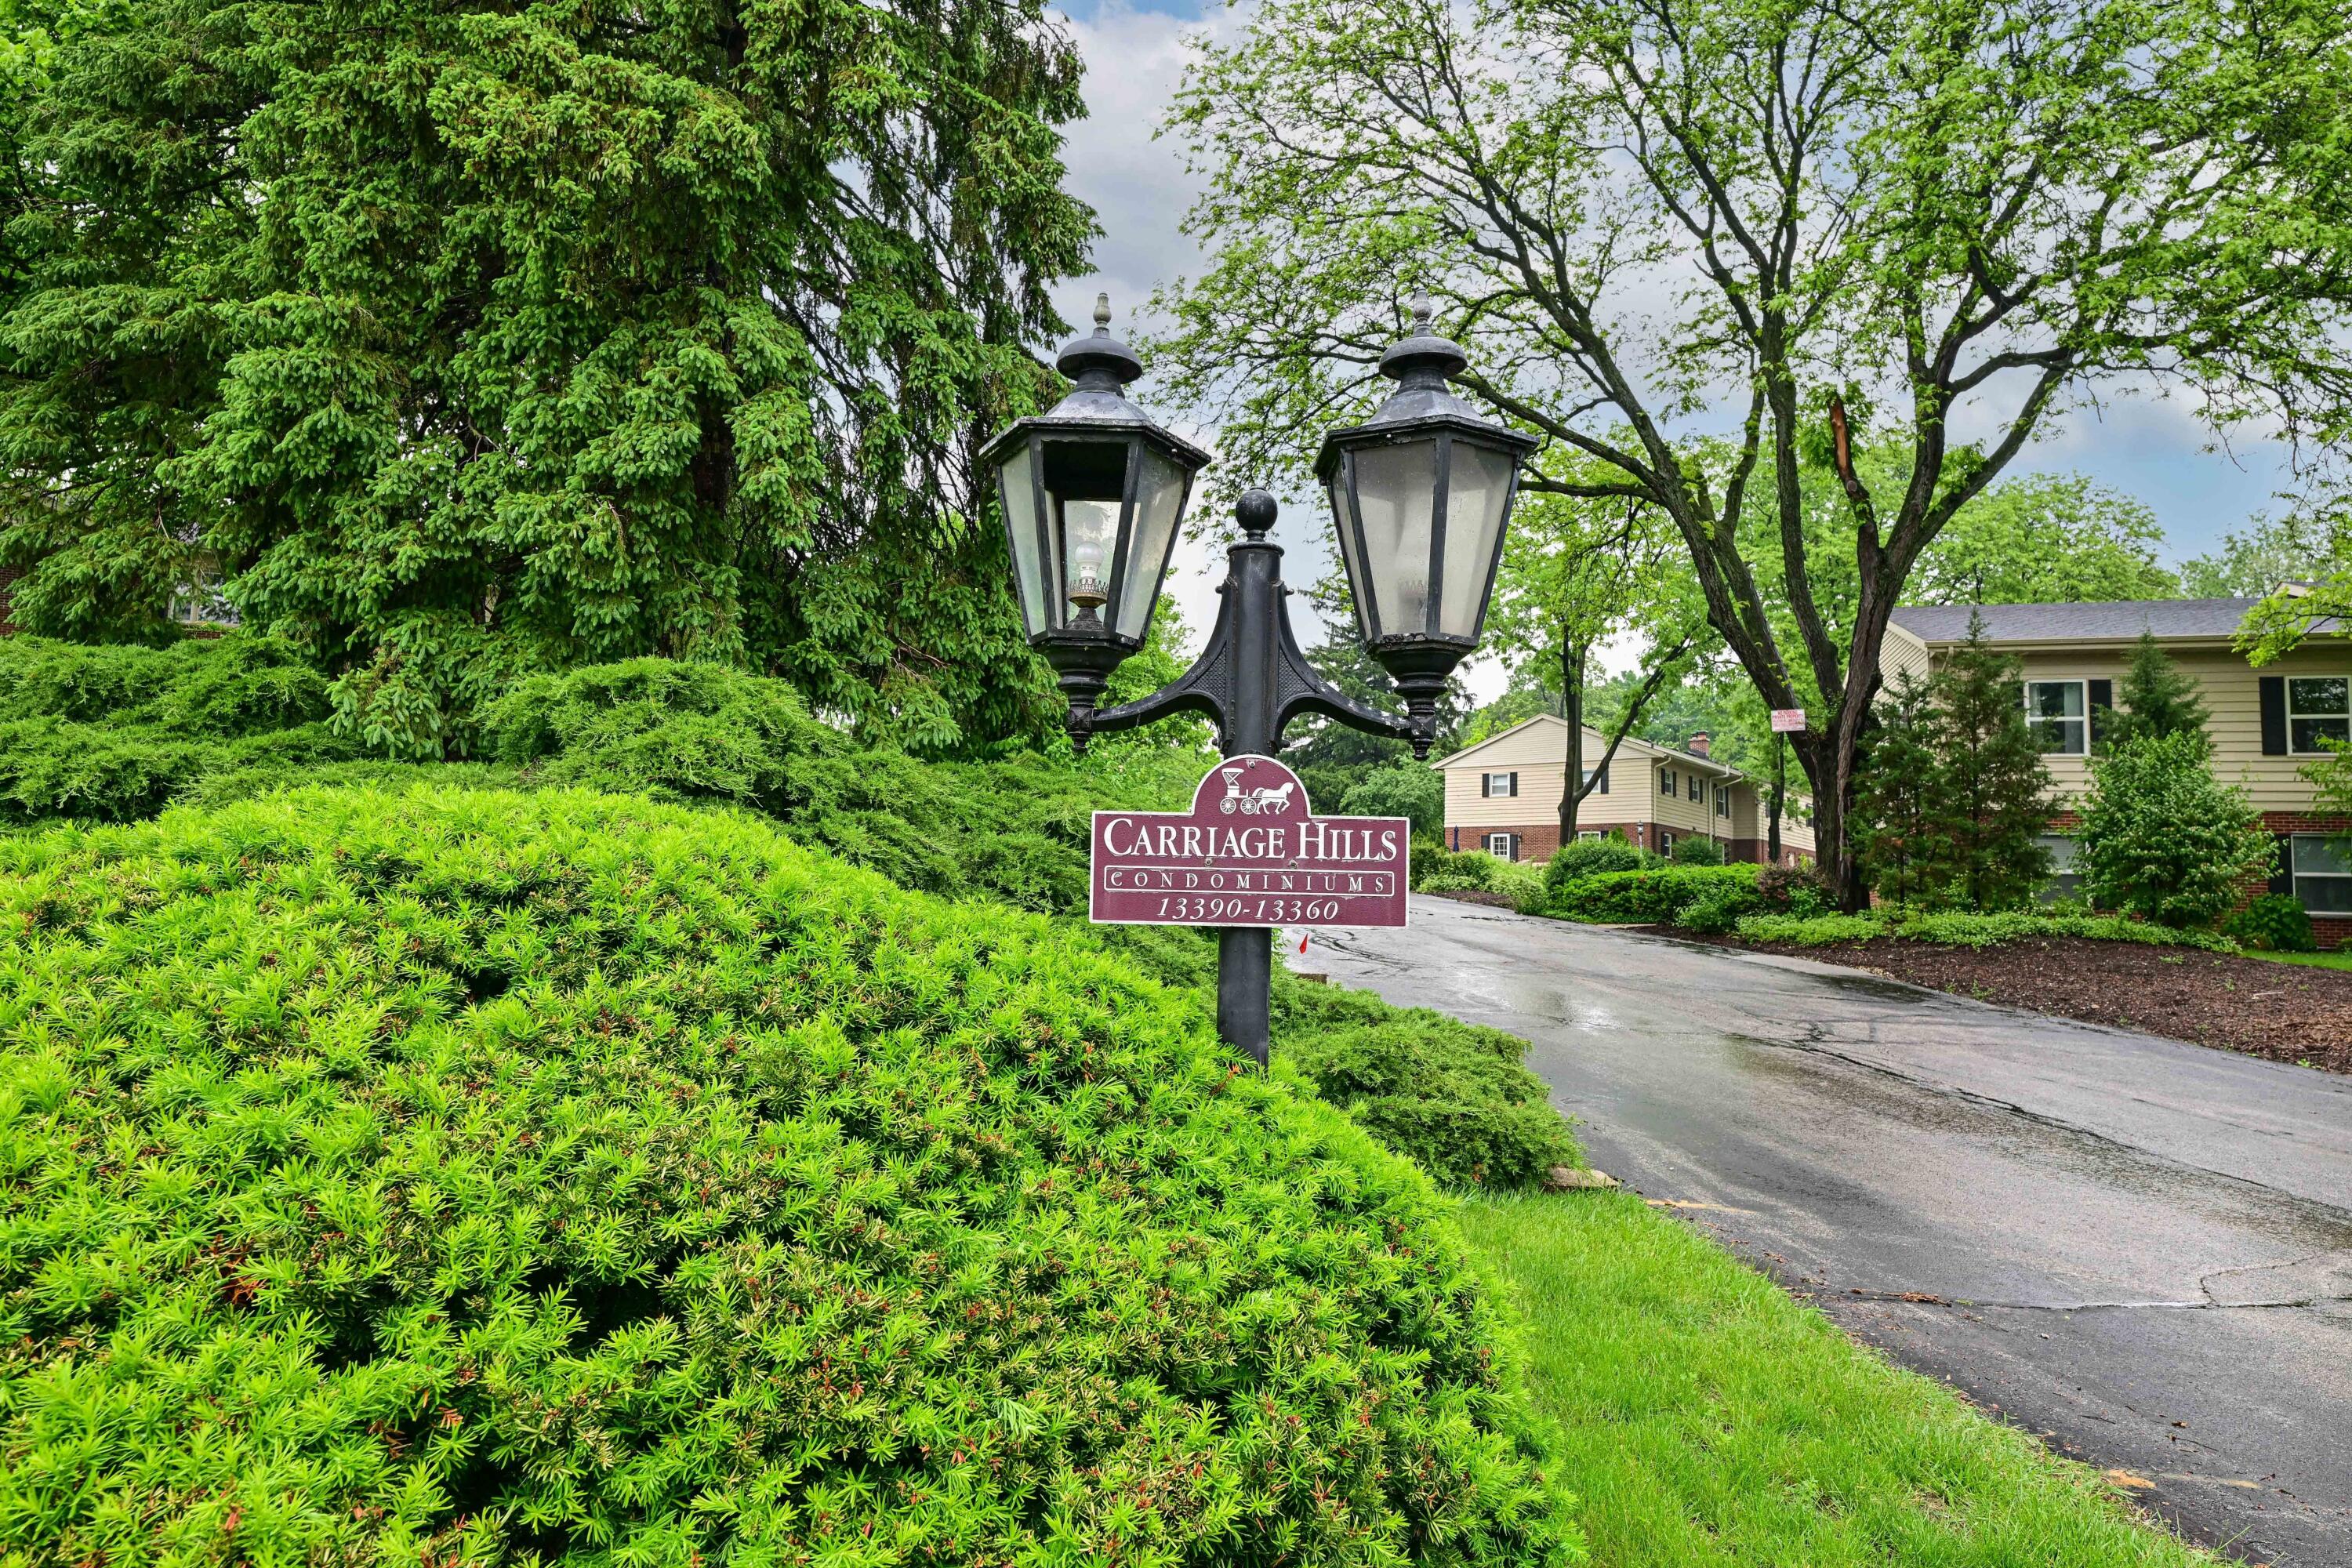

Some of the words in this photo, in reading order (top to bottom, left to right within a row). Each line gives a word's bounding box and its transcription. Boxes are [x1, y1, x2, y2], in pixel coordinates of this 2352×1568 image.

[1104, 818, 1286, 859] CARRIAGE
[1296, 822, 1397, 862] HILLS
[1110, 871, 1385, 892] CONDOMINIUMS
[1157, 898, 1339, 921] 13390-13360
